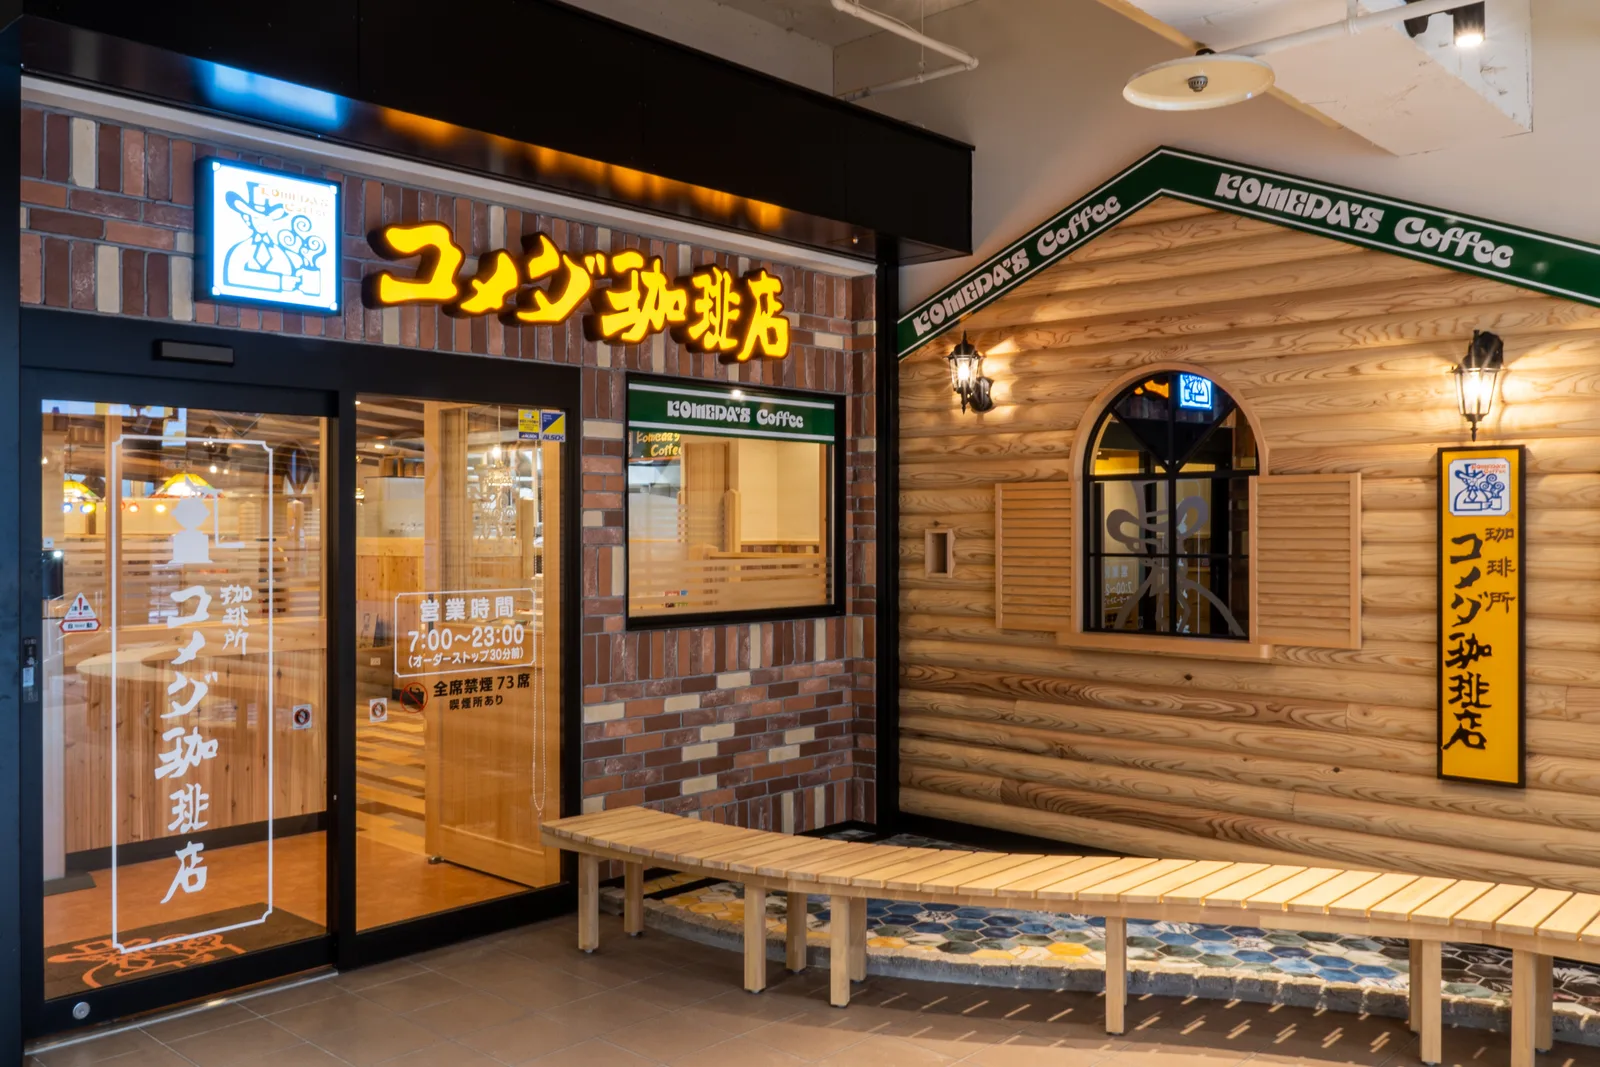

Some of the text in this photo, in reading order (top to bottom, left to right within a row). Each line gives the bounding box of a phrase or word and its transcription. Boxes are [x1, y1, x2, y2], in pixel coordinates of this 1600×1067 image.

[912, 196, 1121, 336] KOMEDA'S Coffee
[1214, 173, 1514, 268] KOMEDA'S Coffee
[379, 222, 789, 361] コメダ珈琲店
[667, 400, 804, 429] KOMEDA'S Coffee
[420, 595, 514, 622] 営業時間
[1485, 527, 1516, 614] 珈琲所
[219, 583, 253, 655] 珈琲所
[1441, 533, 1492, 750] コメダ珈琲店
[154, 585, 219, 904] コメダ珈琲店
[449, 694, 503, 711] 喫煙所あり
